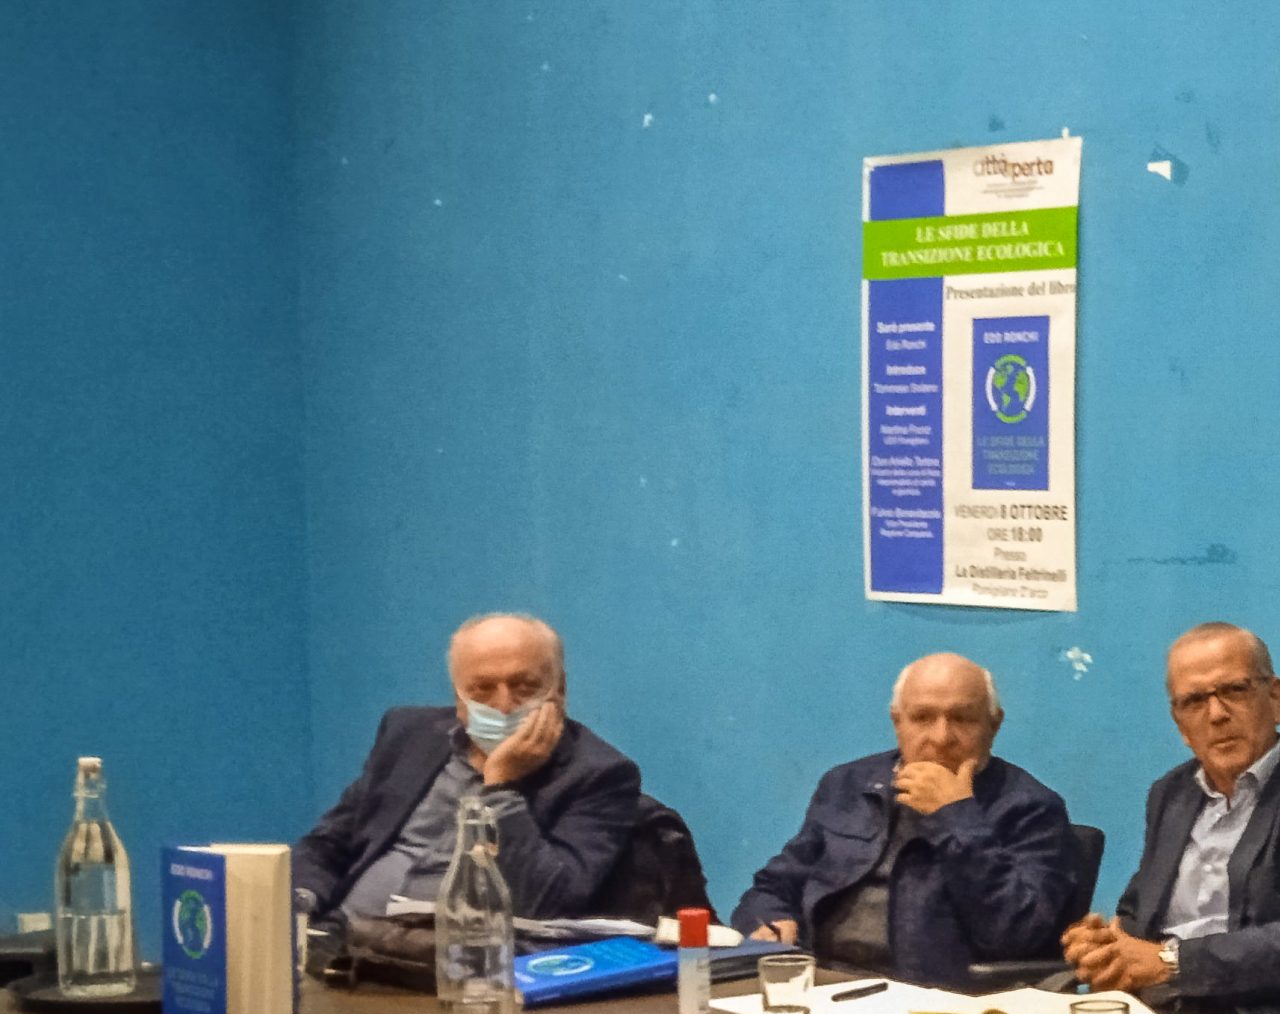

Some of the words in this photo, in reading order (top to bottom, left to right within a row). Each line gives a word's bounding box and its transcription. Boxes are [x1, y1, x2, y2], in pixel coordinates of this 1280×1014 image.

[916, 226, 935, 243] LE
[938, 223, 974, 241] SFIDE
[981, 220, 1030, 239] DELLA
[881, 246, 973, 267] TRANSIZIONE
[977, 241, 1064, 261] ECOLOGICA
[946, 283, 1025, 300] Presentazione
[1027, 281, 1046, 297] del
[1009, 504, 1068, 521] OTTOBRE
